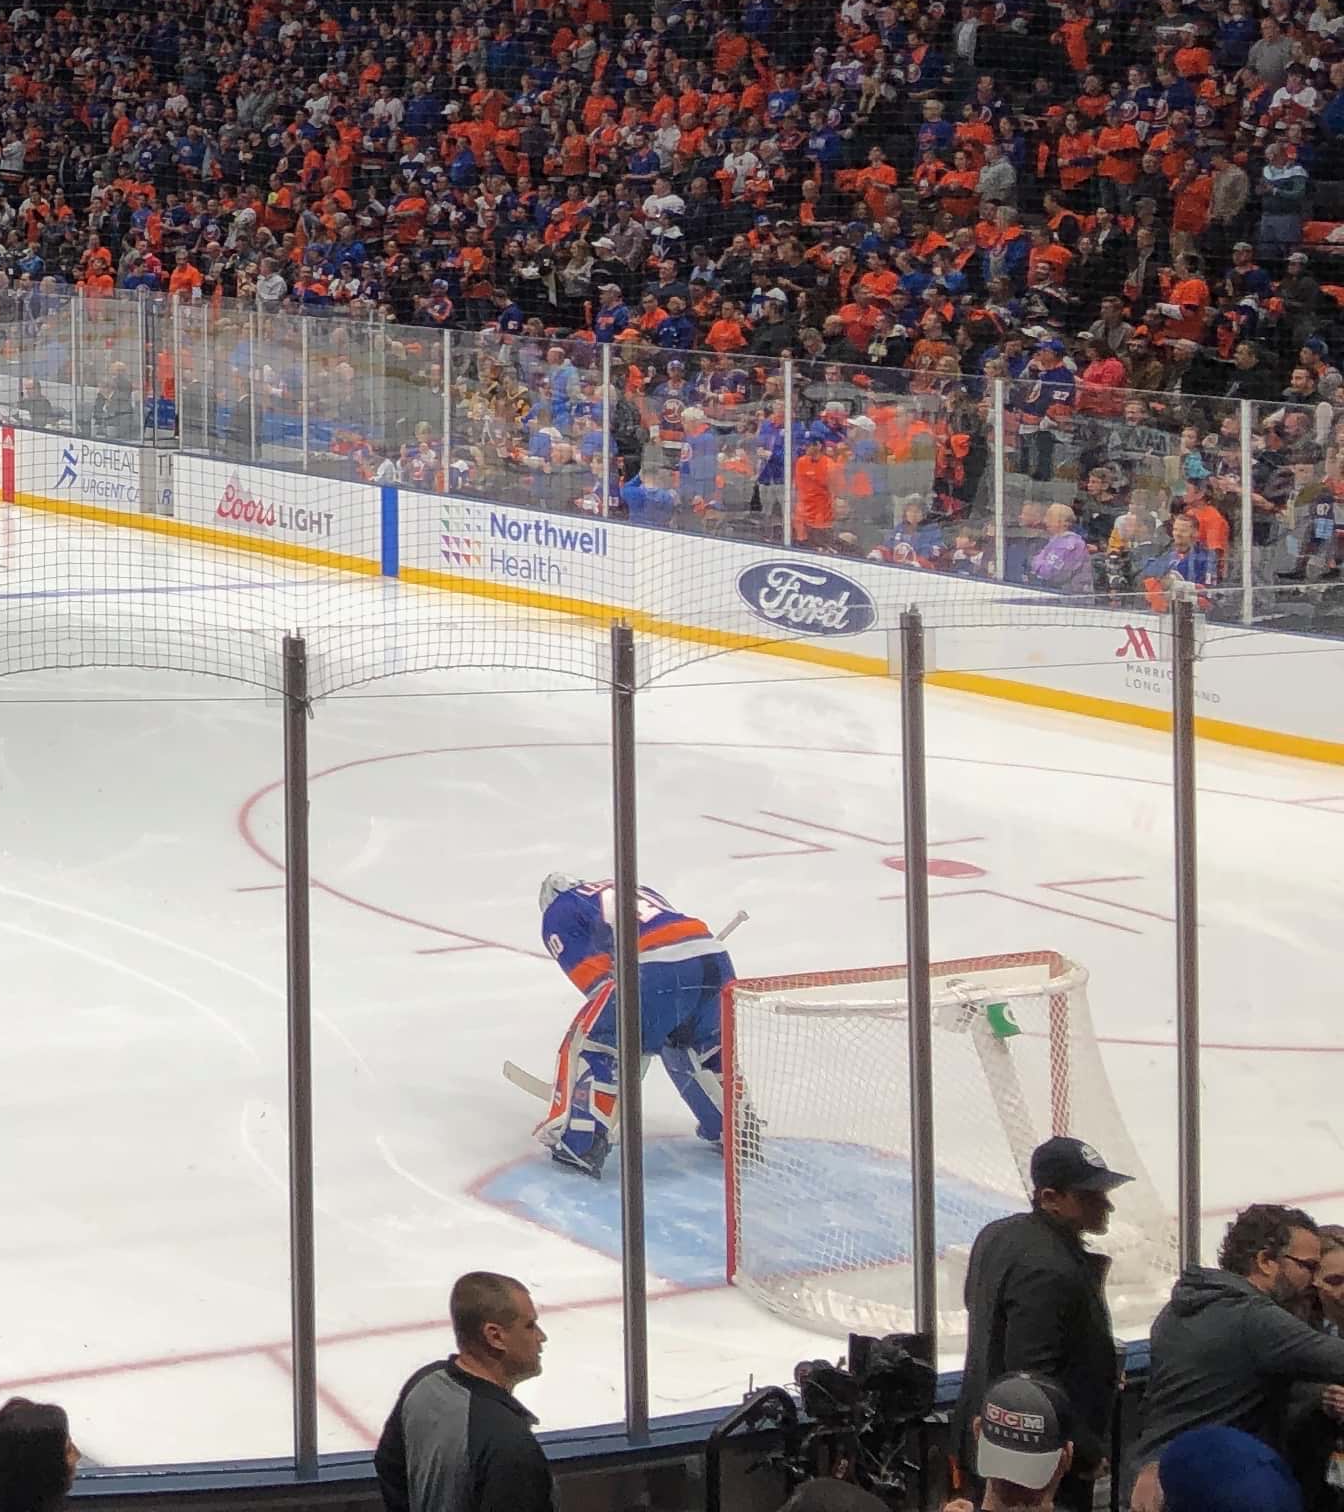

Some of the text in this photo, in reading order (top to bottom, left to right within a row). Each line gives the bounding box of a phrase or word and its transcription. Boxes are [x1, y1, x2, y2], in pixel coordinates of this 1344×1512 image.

[81, 479, 126, 498] URGENT
[216, 485, 334, 537] Coors LIGHT
[490, 512, 608, 555] Northwell
[490, 548, 562, 585] Health
[760, 568, 849, 631] Ford
[1126, 677, 1161, 694] LONG
